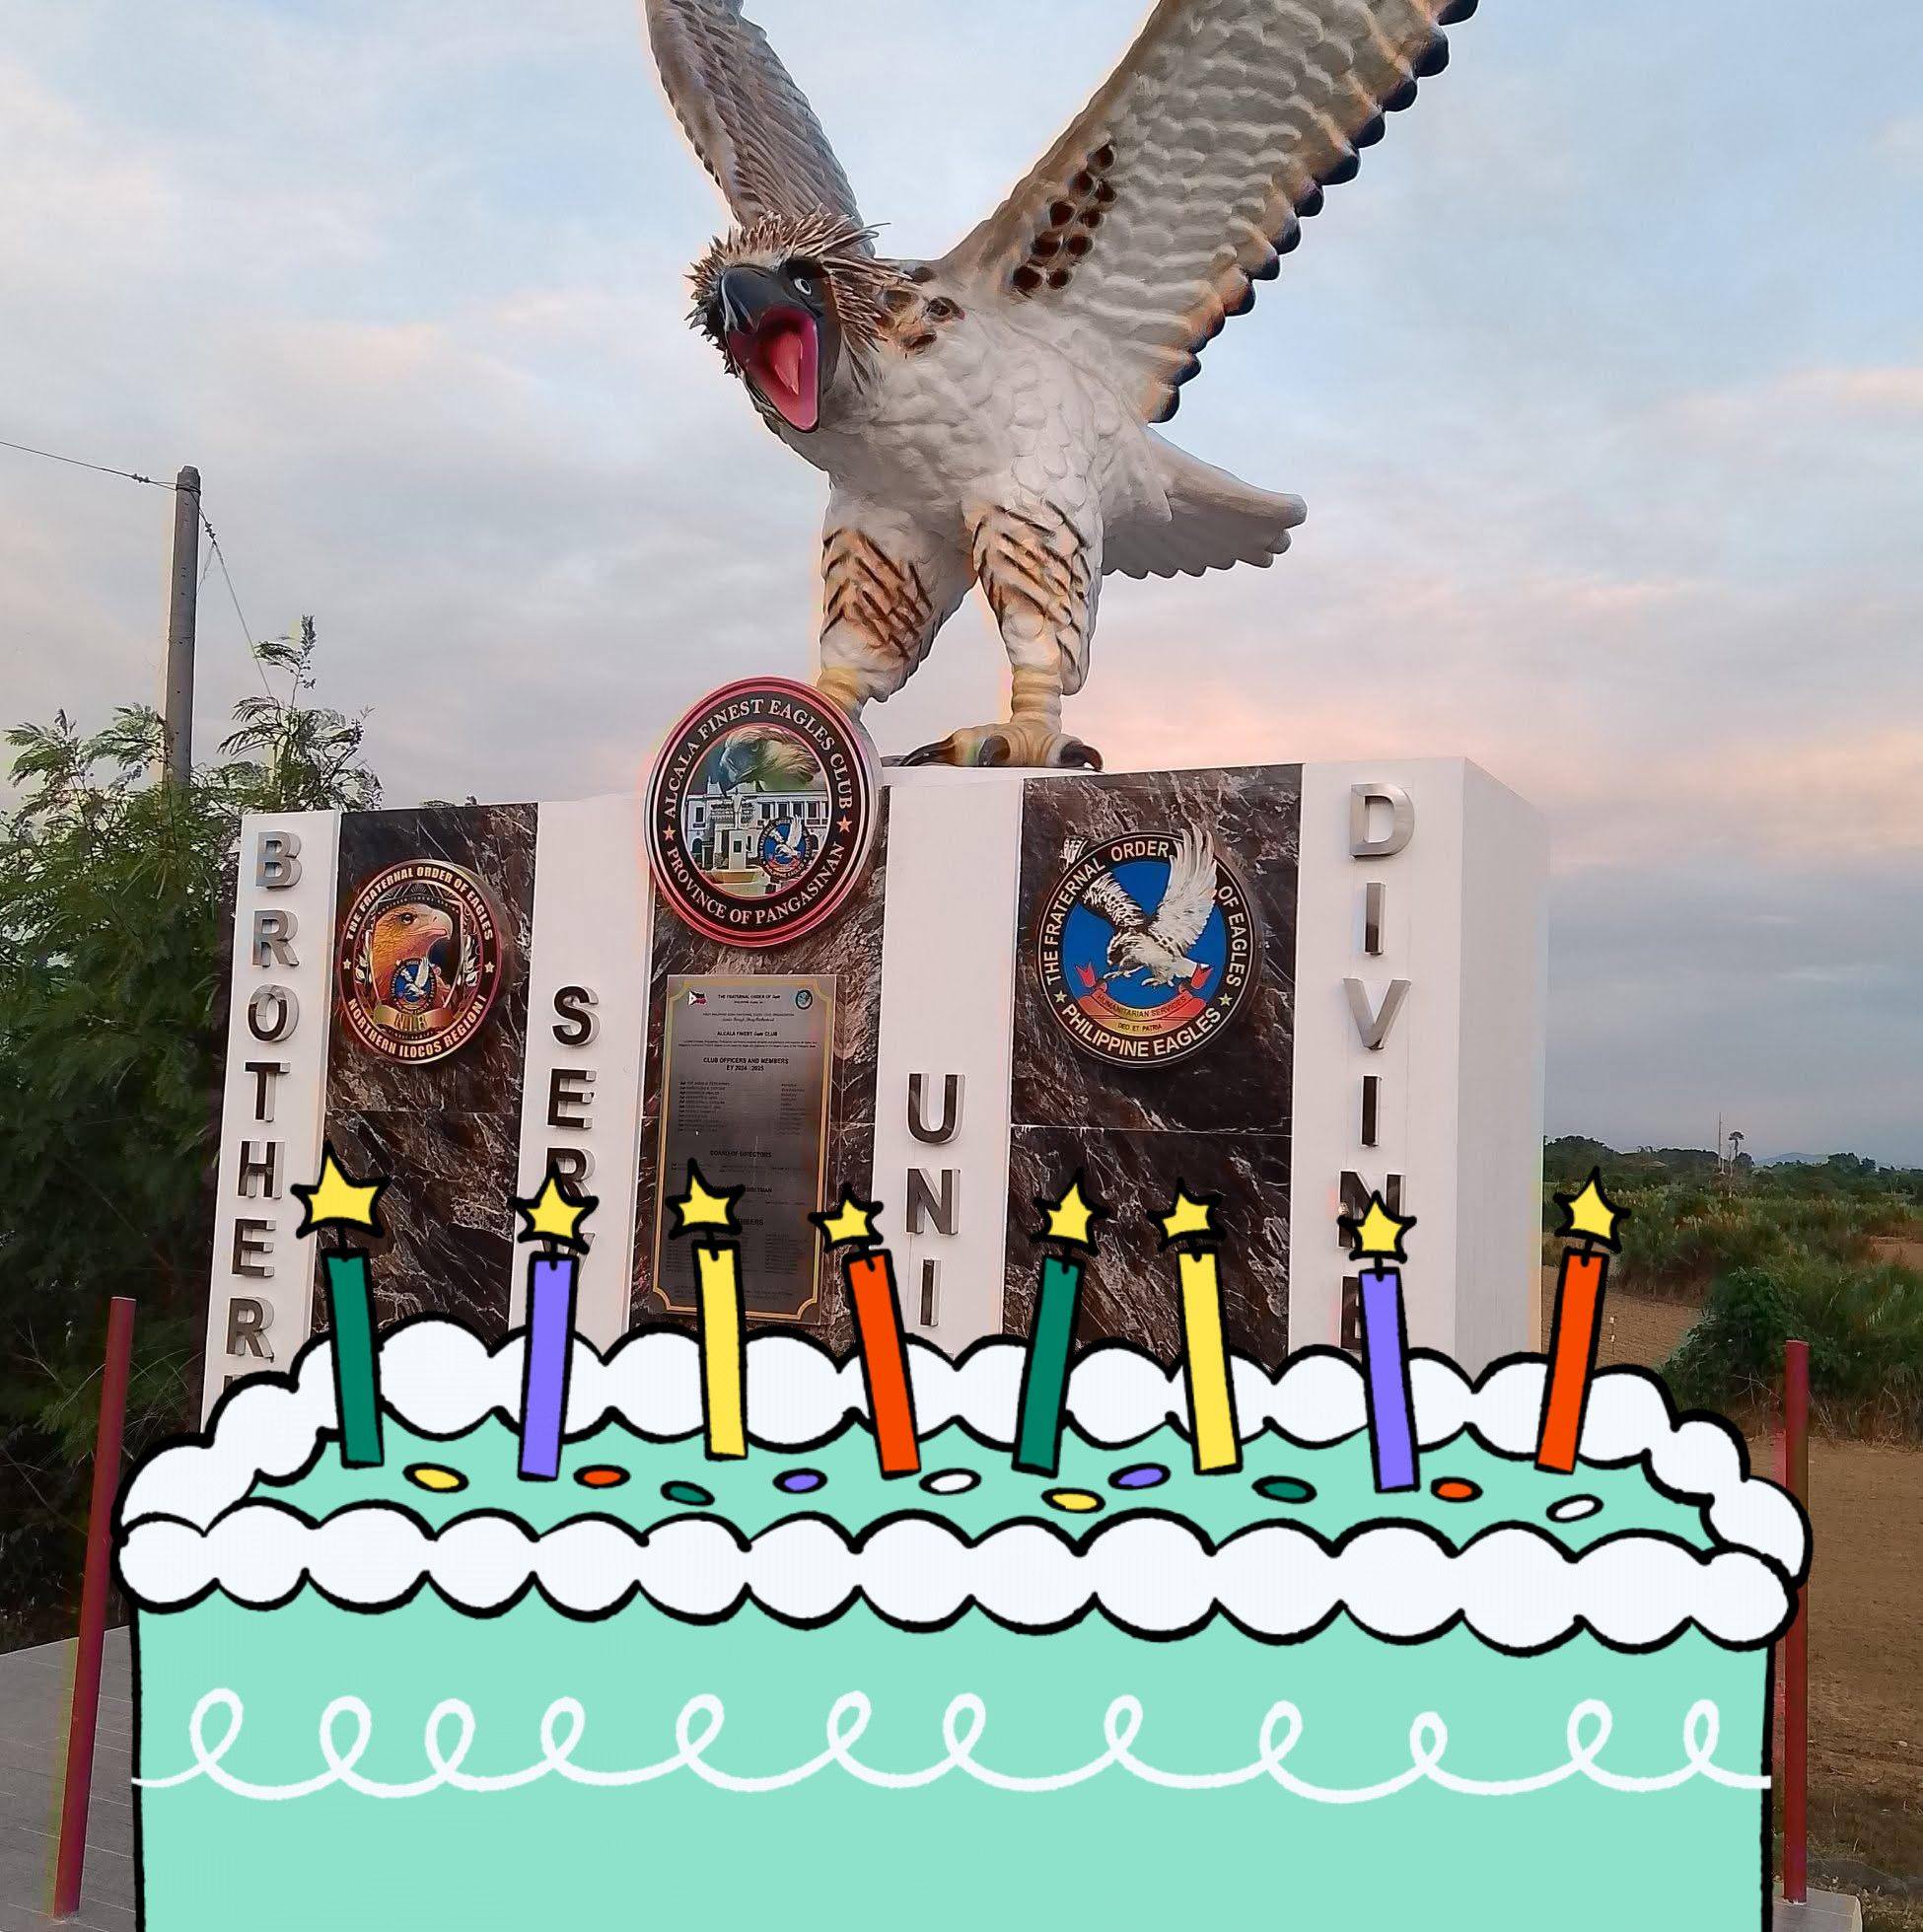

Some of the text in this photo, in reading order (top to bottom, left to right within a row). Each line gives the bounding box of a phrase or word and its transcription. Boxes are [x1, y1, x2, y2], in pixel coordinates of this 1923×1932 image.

[664, 698, 854, 820] ALCALA FINEST EAGLES CLUB
[346, 913, 362, 941] THE
[360, 867, 412, 915] FRATERNAL
[416, 866, 452, 883] ORDER
[454, 877, 467, 893] OF
[465, 889, 493, 941] EAGLES
[666, 847, 728, 920] PROVINCE
[729, 907, 753, 925] OF
[754, 840, 846, 925] PANGASINAN
[1043, 839, 1248, 987] THE FRATERNAL ORDER OF EAGLES
[347, 998, 396, 1055] NORTHERN
[398, 1042, 443, 1059] ILOCOS
[443, 1004, 486, 1052] REGION
[1061, 1003, 1222, 1057] PHILIPPINE EAGLES
[1098, 994, 1187, 1018] HUMANITARIAN SERVICES
[222, 830, 303, 1394] BROTHER
[904, 1072, 966, 1359] UNI
